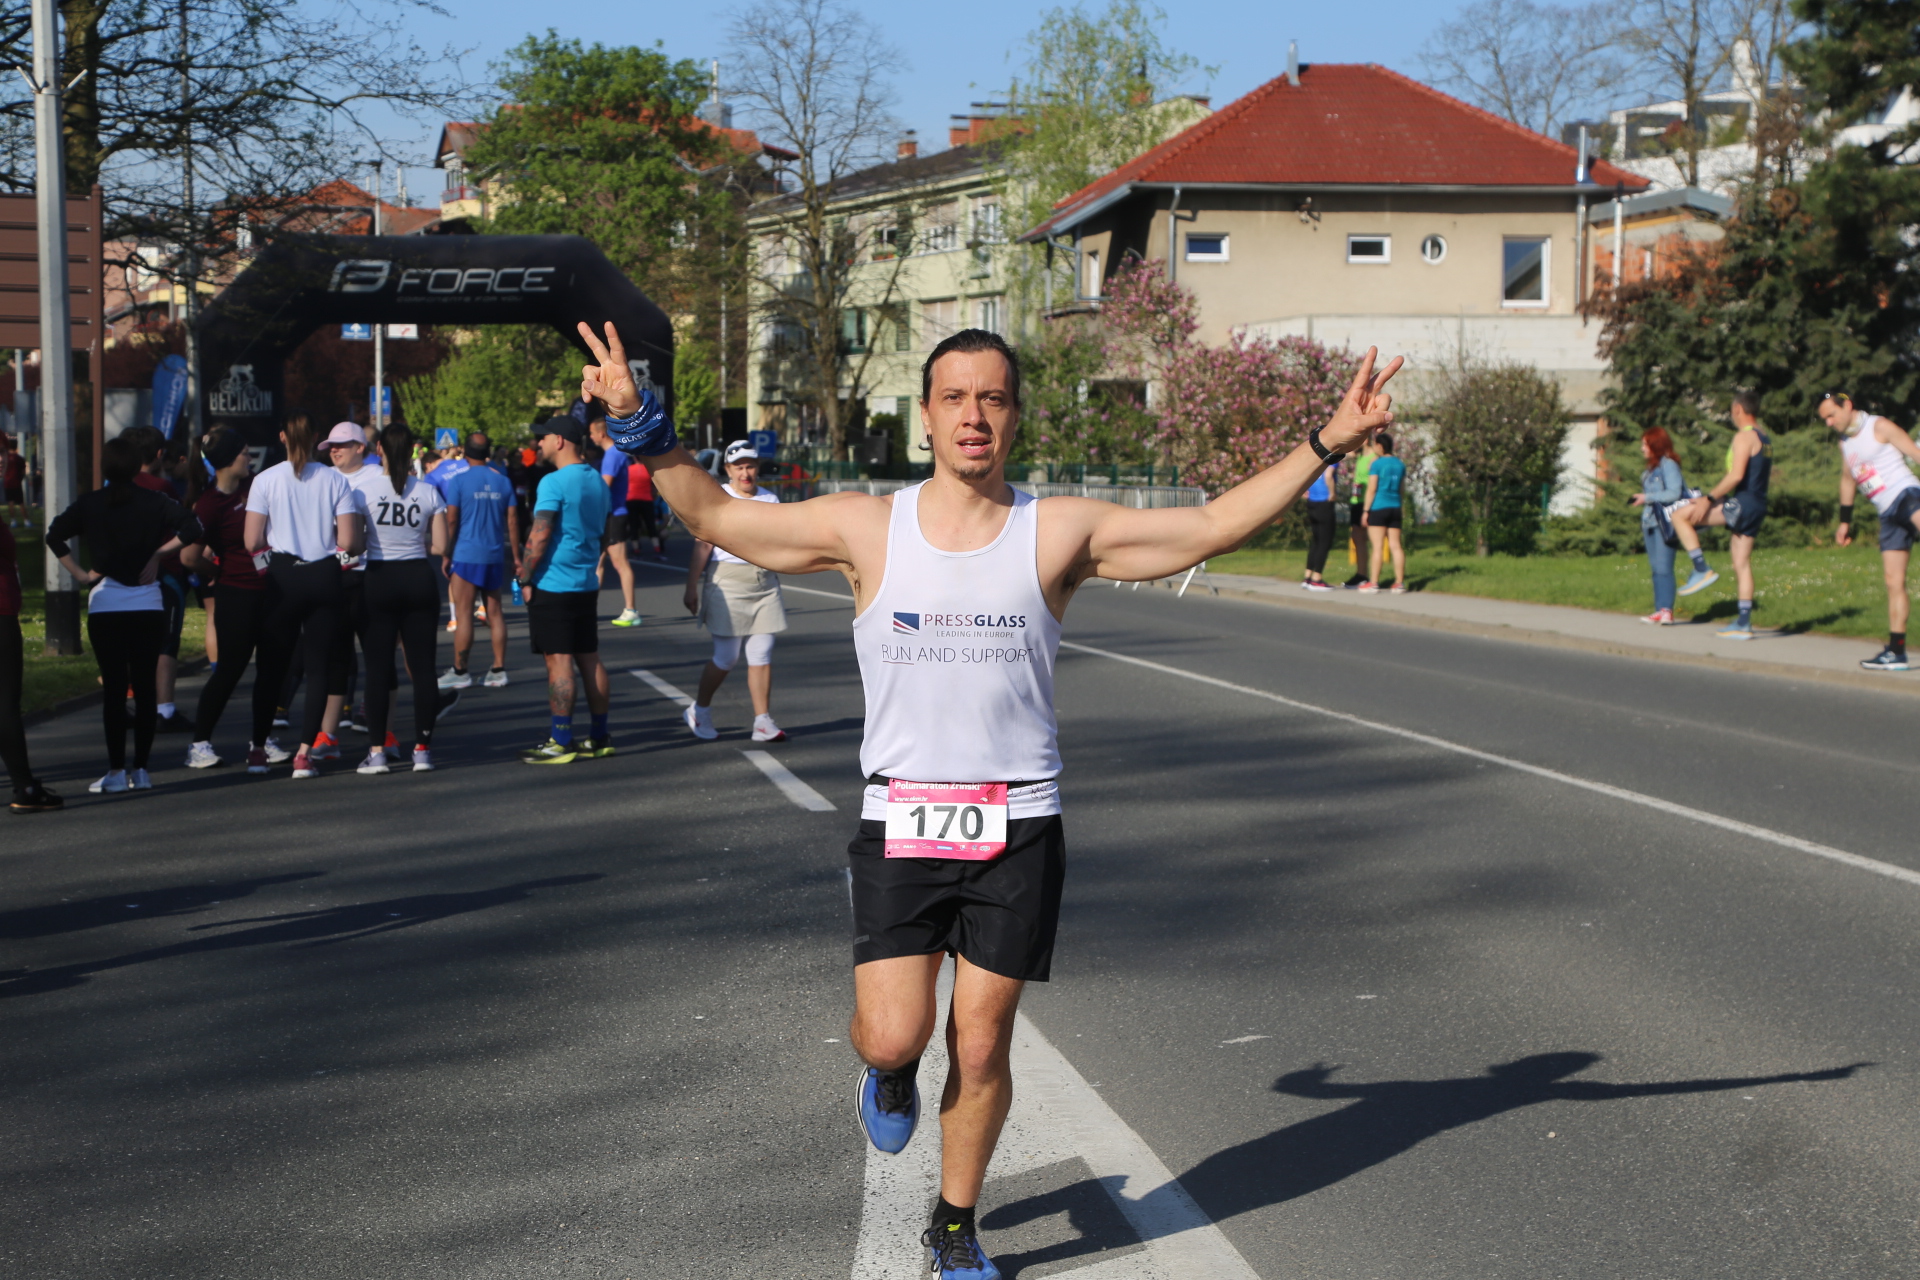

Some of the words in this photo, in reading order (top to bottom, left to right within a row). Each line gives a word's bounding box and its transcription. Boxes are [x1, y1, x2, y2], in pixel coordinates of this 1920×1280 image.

[397, 267, 555, 293] FORCE
[755, 433, 770, 454] P
[376, 496, 421, 528] ŽBČ
[924, 613, 1026, 628] PRESSGLASS
[936, 630, 972, 638] LEADING
[984, 631, 1015, 639] EUROPE
[881, 643, 912, 661] RUN
[917, 647, 956, 663] AND
[961, 648, 1034, 664] SUPPORT
[895, 781, 949, 790] Polumaraton
[909, 805, 984, 840] 170
